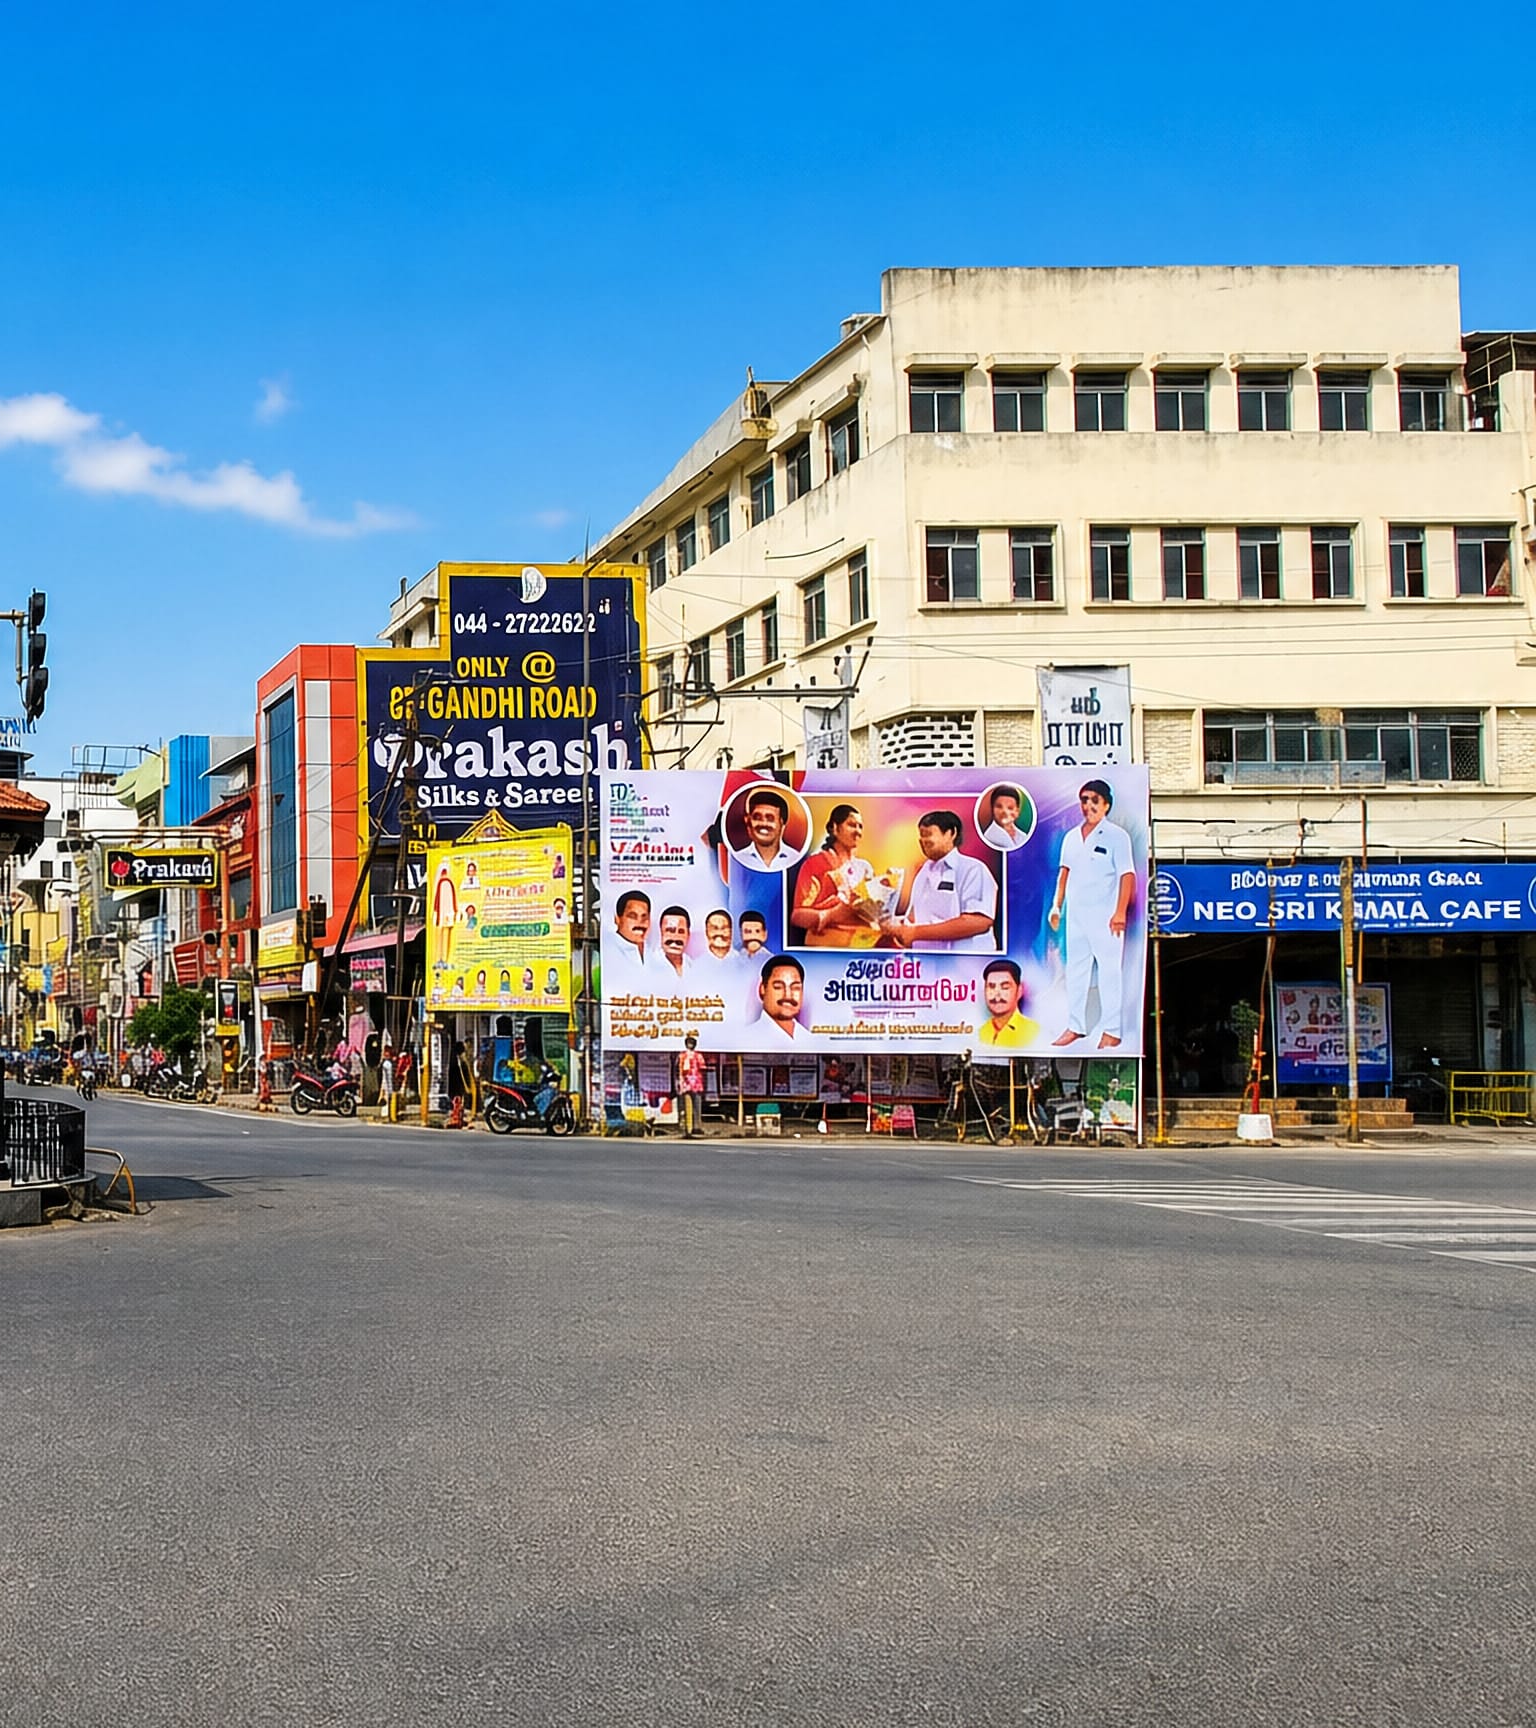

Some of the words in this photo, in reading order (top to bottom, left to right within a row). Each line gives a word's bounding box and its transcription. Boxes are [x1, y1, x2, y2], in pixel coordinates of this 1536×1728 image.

[454, 613, 487, 633] 044
[505, 613, 596, 633] 27222622
[457, 657, 509, 678] ONLY
[522, 651, 556, 683] @
[428, 686, 524, 719] GANDHI
[530, 686, 597, 719] ROAD
[373, 725, 633, 779] Prakash
[417, 785, 480, 808] Silks
[484, 786, 501, 807] &
[1193, 901, 1257, 920] NEO
[1268, 901, 1315, 920] SRI
[1325, 901, 1429, 920] KMALA
[1440, 901, 1521, 920] CAFE
